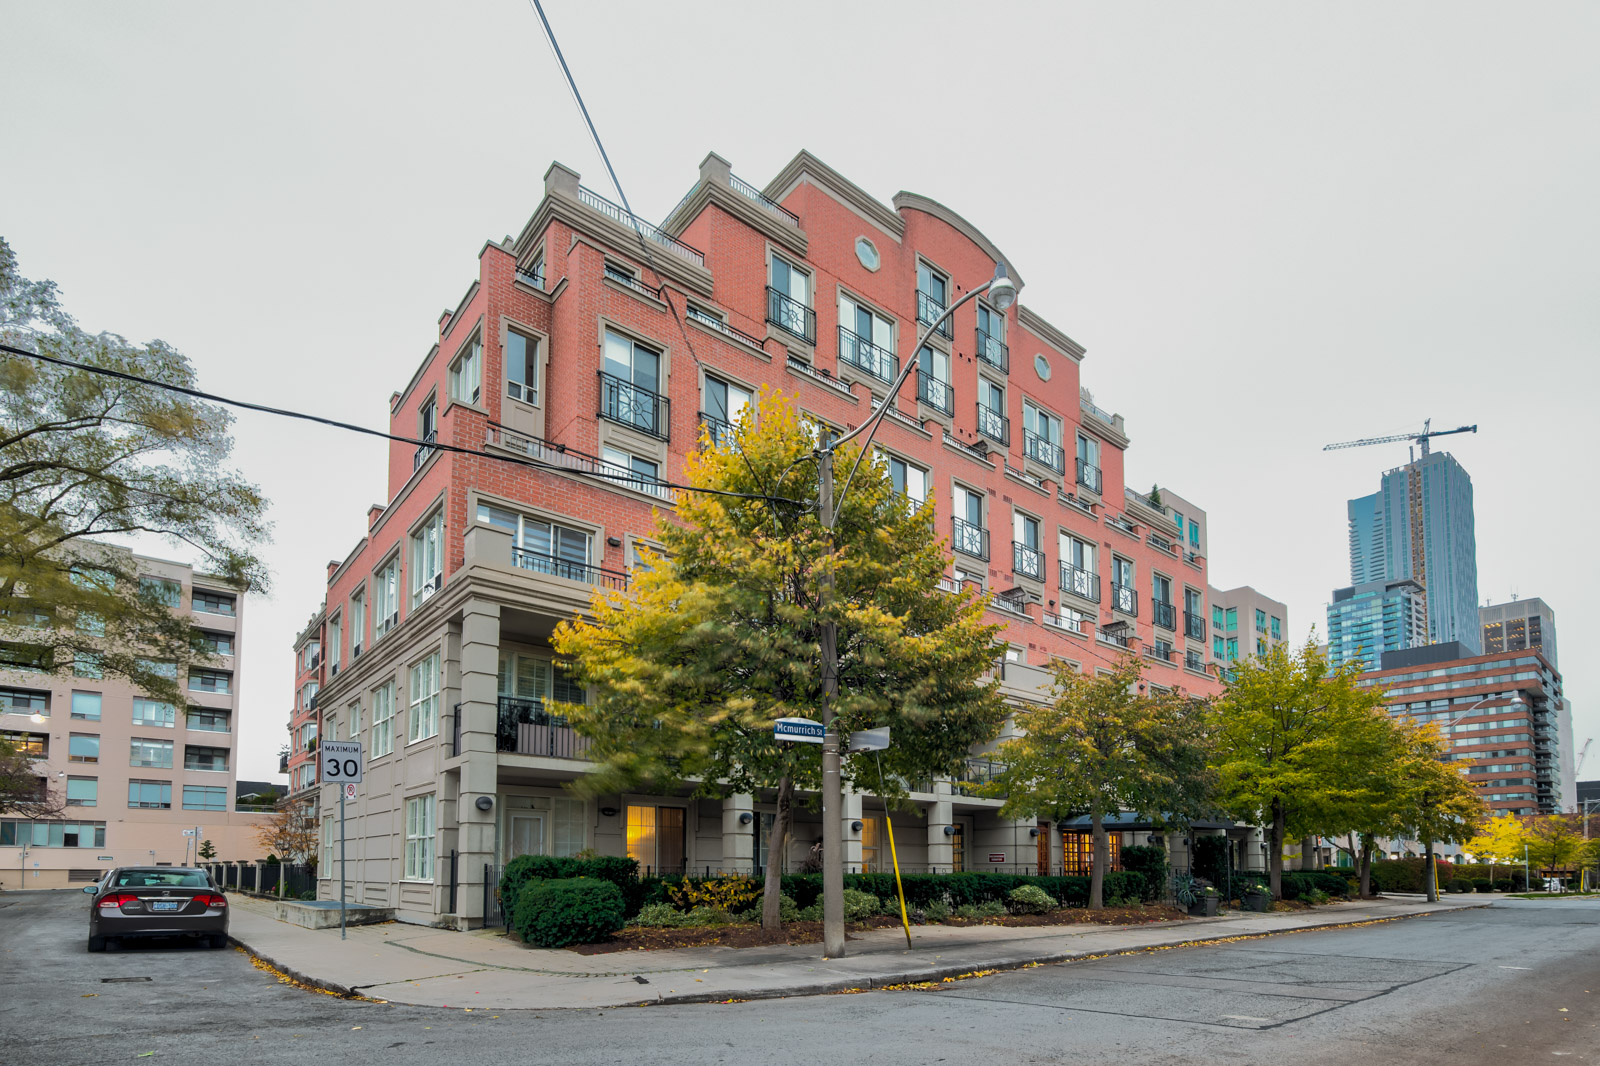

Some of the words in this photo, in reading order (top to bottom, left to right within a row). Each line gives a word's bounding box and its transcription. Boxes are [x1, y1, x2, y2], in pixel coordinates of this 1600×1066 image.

[777, 723, 816, 735] Mcmurrich
[324, 745, 359, 753] MAXIMUM
[326, 758, 358, 777] 30
